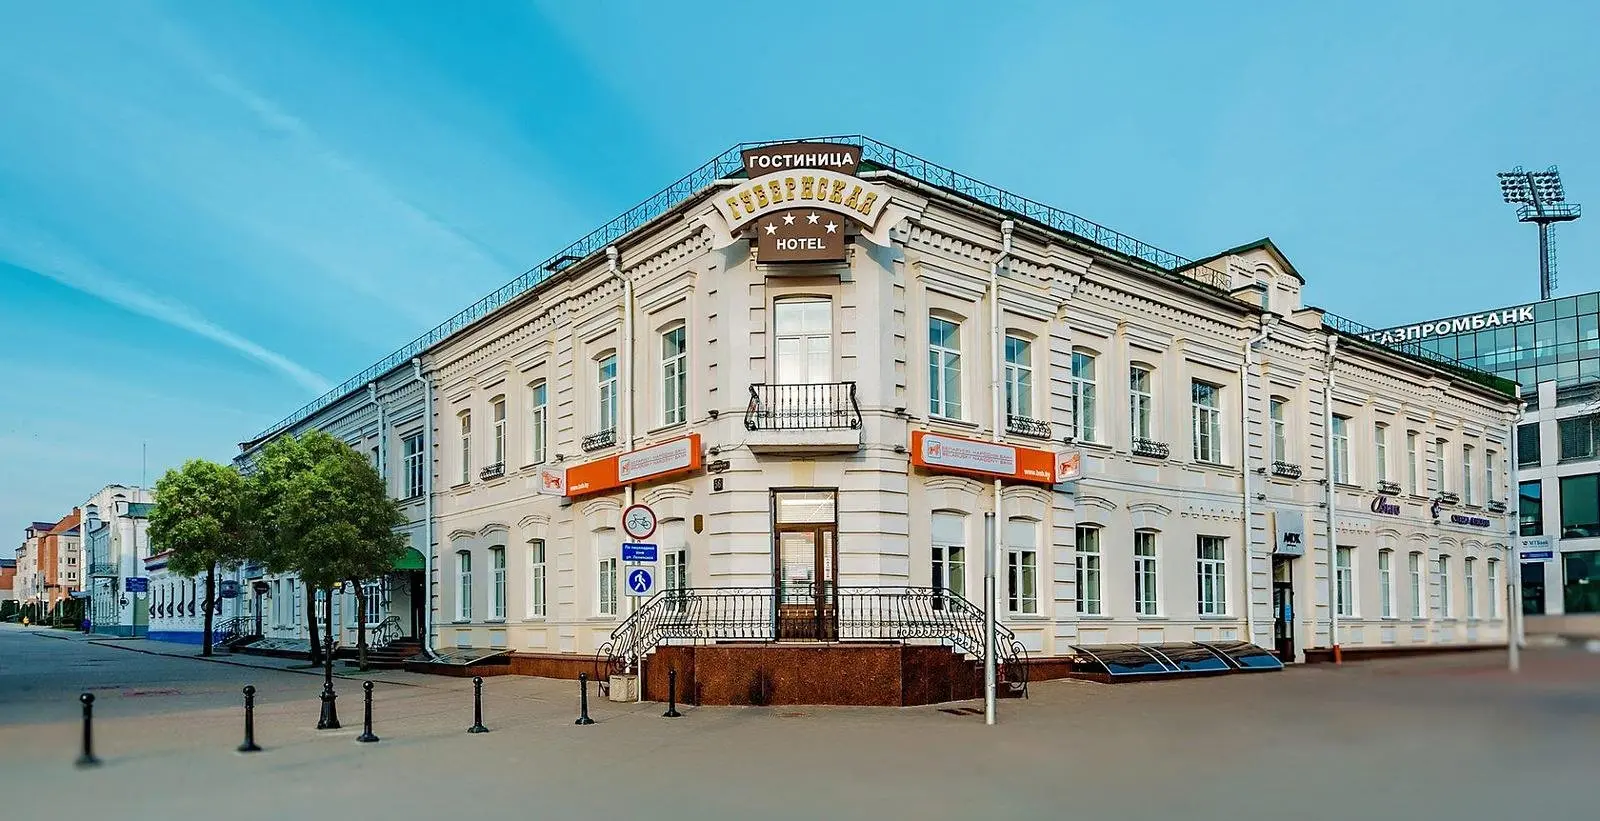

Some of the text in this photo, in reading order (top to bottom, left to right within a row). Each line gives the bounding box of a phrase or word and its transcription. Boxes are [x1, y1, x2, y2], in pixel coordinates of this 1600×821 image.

[749, 152, 854, 169] ГОСТИНИЦА
[725, 175, 878, 221] ГУБЕРНСКАЯ
[776, 238, 826, 250] HOTEL
